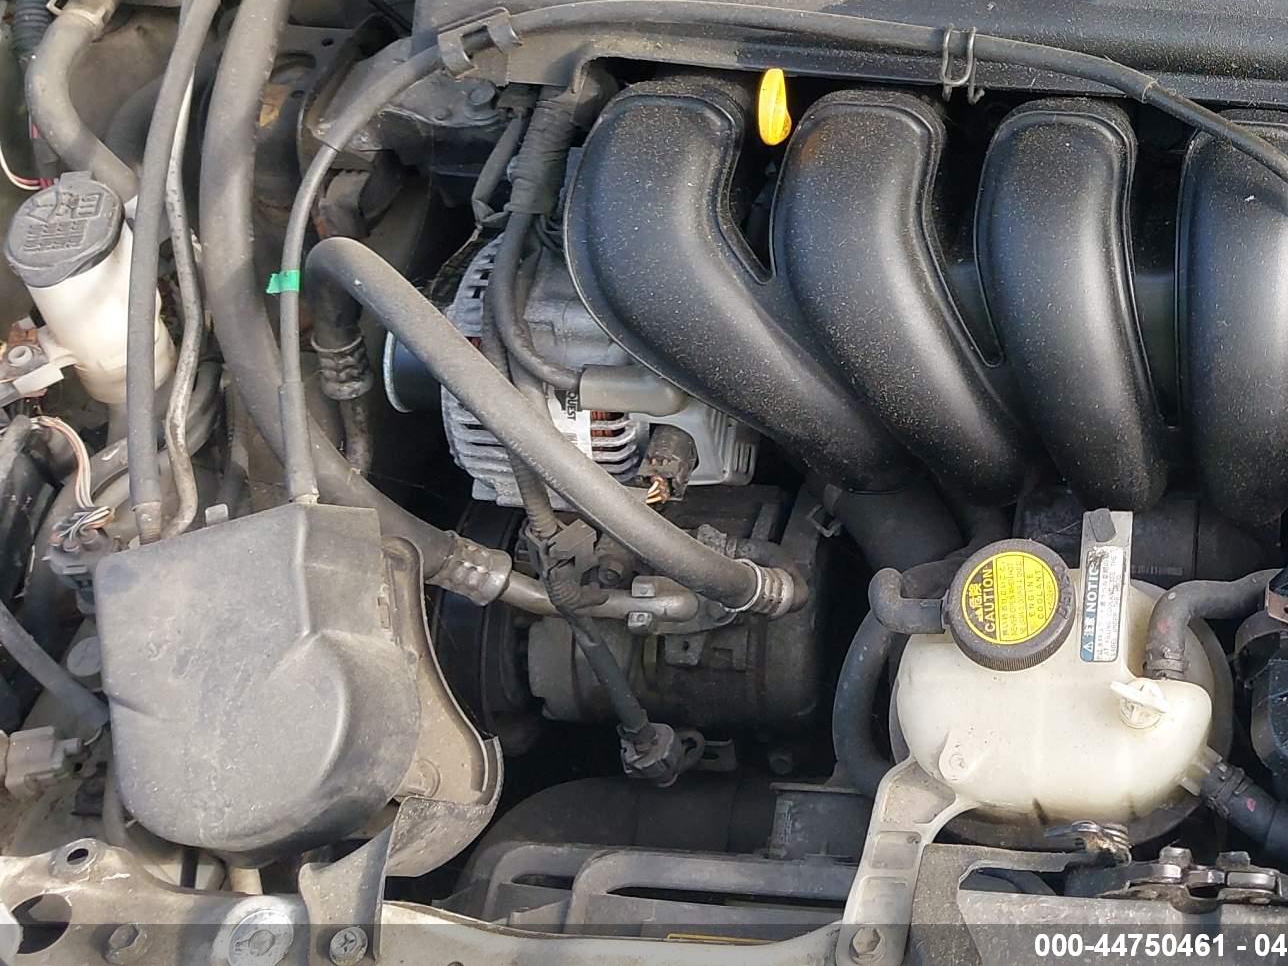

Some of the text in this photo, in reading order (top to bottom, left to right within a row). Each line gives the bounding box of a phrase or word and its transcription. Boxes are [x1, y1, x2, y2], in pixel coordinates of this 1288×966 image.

[983, 568, 996, 632] CAUTION
[1026, 573, 1035, 617] ENGINE
[1035, 569, 1044, 619] COOLANT
[1086, 556, 1099, 613] NOTIC
